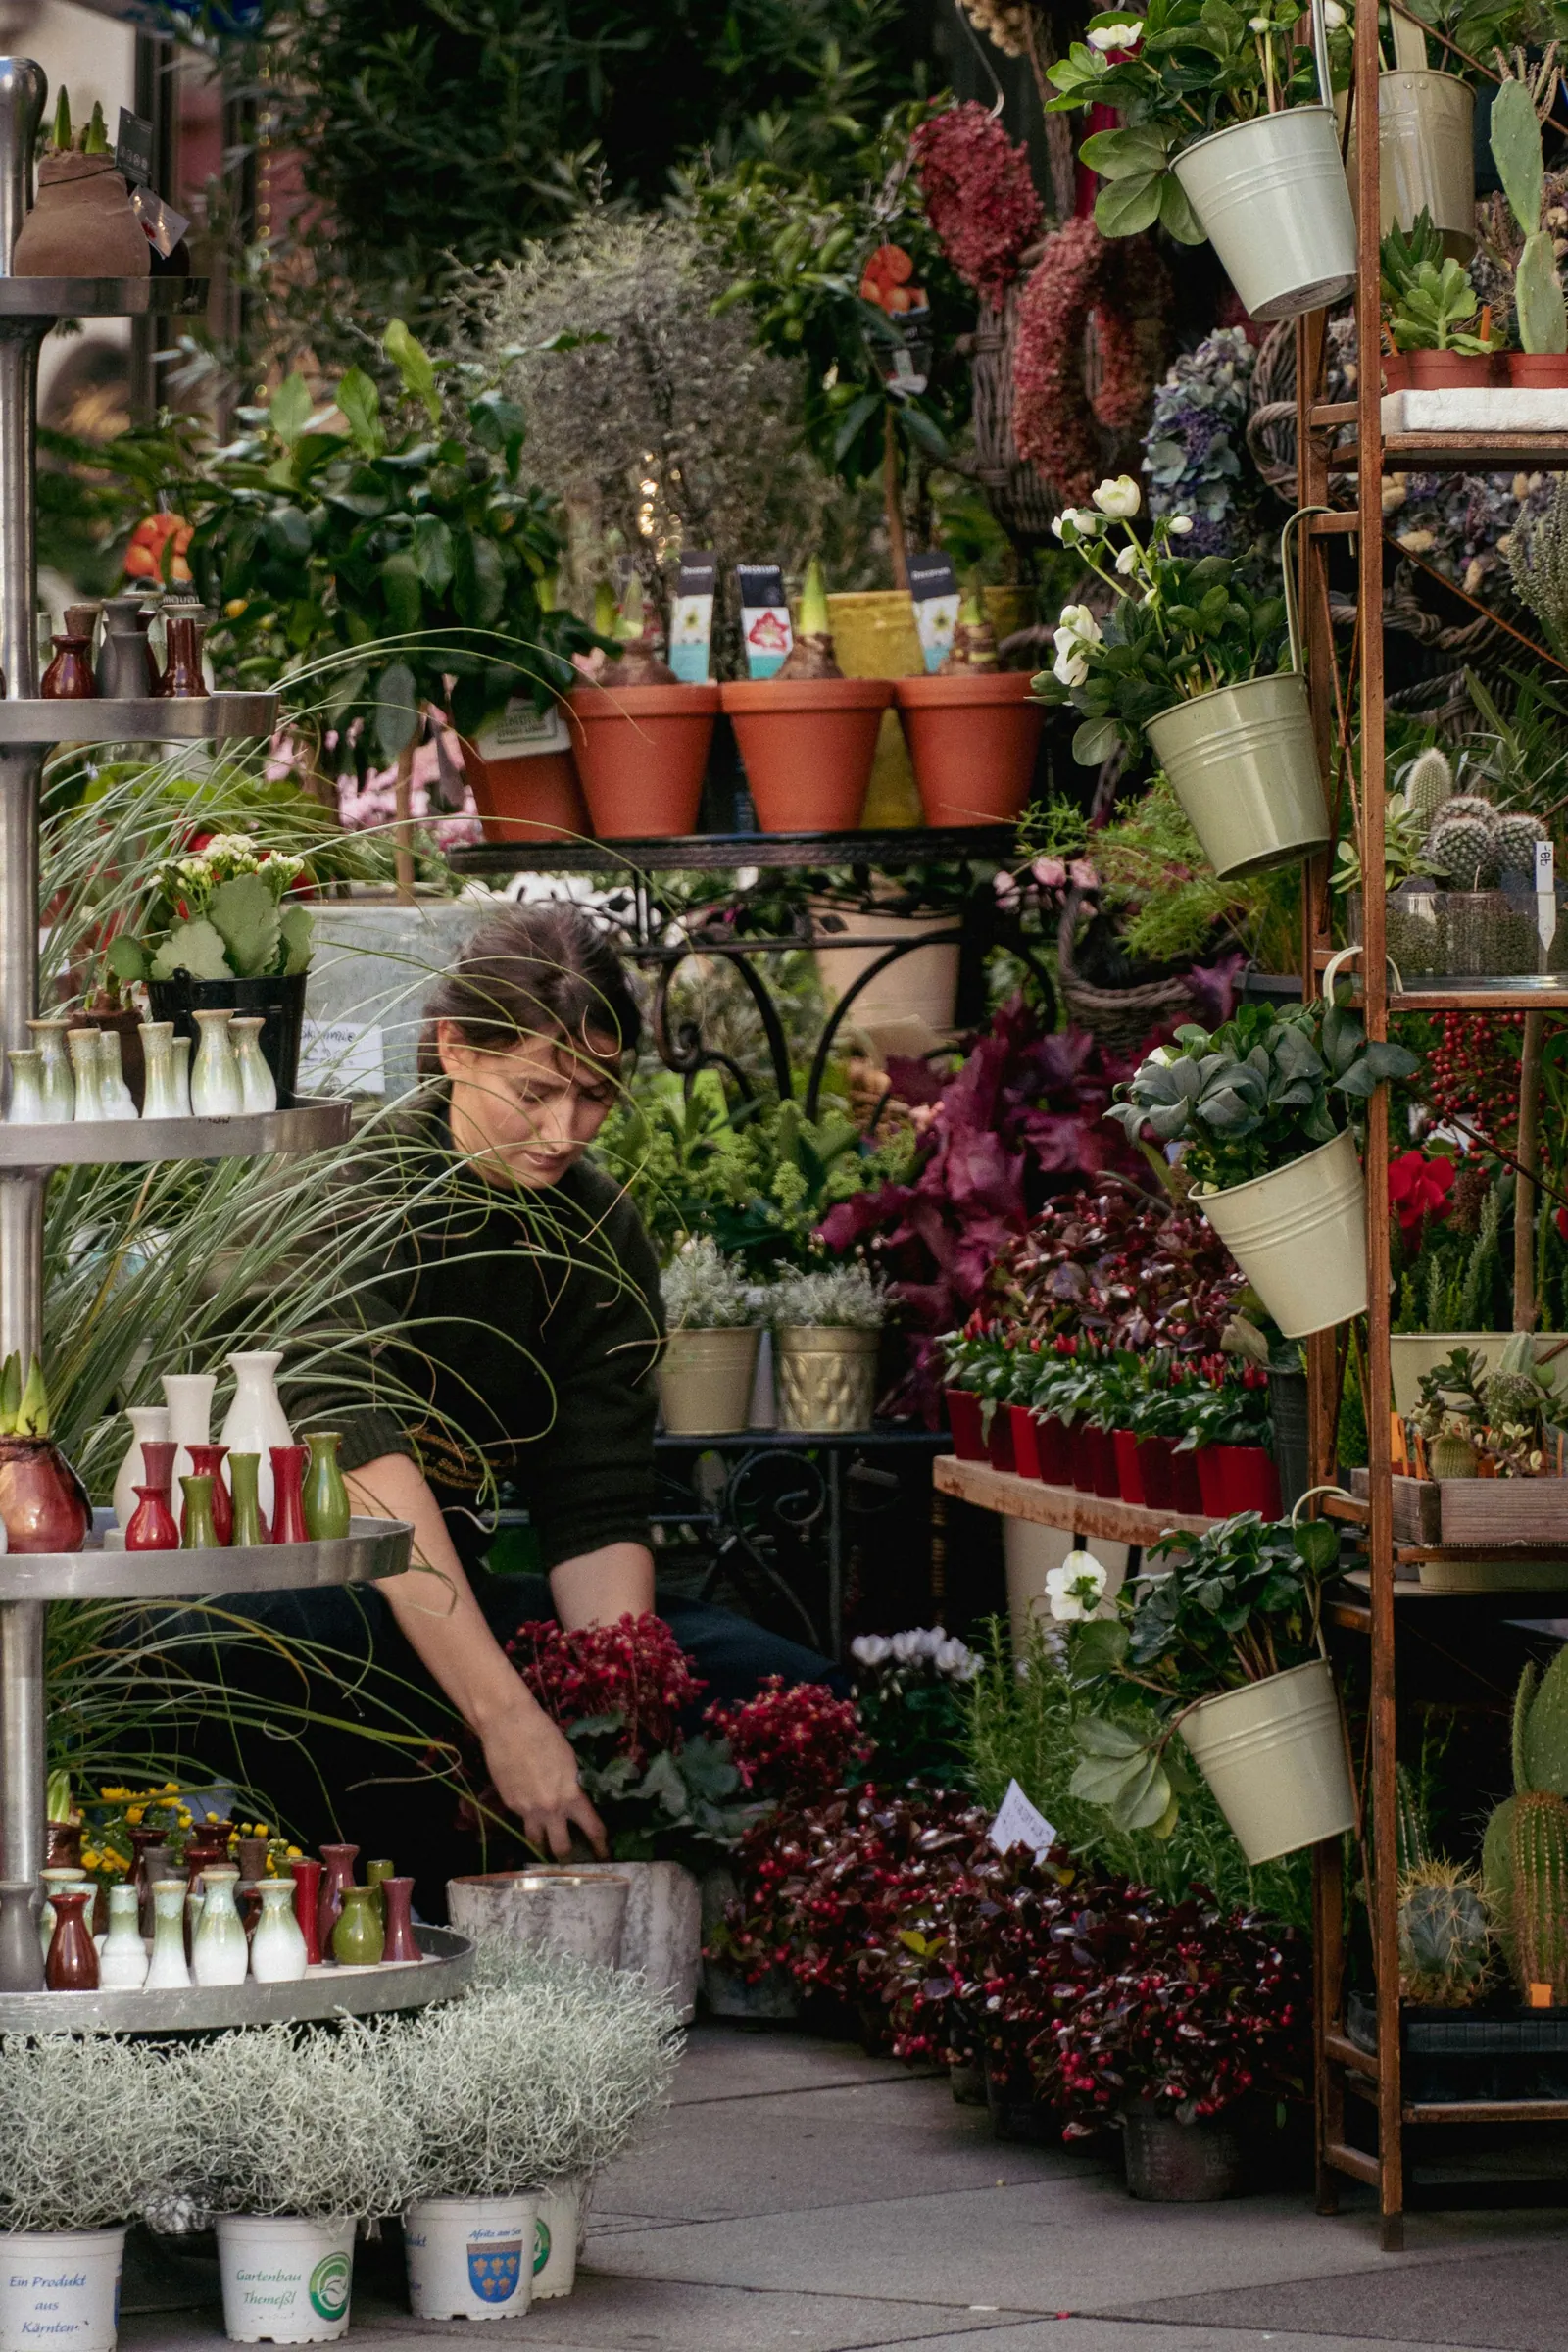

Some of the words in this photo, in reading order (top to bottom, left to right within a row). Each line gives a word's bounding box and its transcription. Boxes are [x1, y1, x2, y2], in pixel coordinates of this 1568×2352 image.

[9, 2276, 28, 2287] Ein
[32, 2273, 86, 2287] Produkt
[236, 2269, 301, 2281] Gartenbau
[21, 2321, 75, 2332] Kärnten
